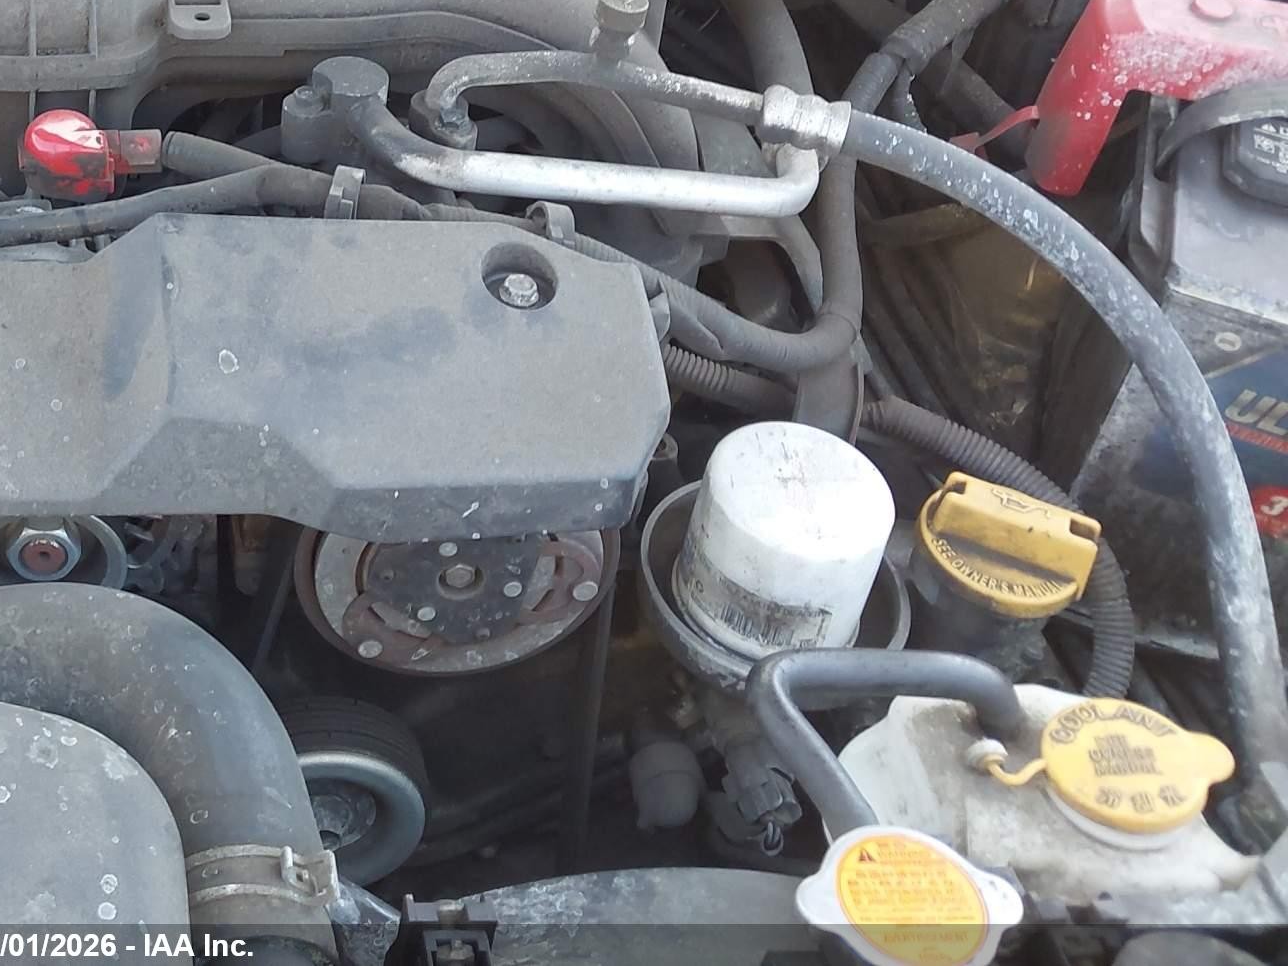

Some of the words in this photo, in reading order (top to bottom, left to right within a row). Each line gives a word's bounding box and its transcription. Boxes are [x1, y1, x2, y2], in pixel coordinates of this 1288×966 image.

[932, 537, 956, 560] SEE
[1011, 579, 1063, 599] MANUAL
[1049, 703, 1178, 745] COOLANT
